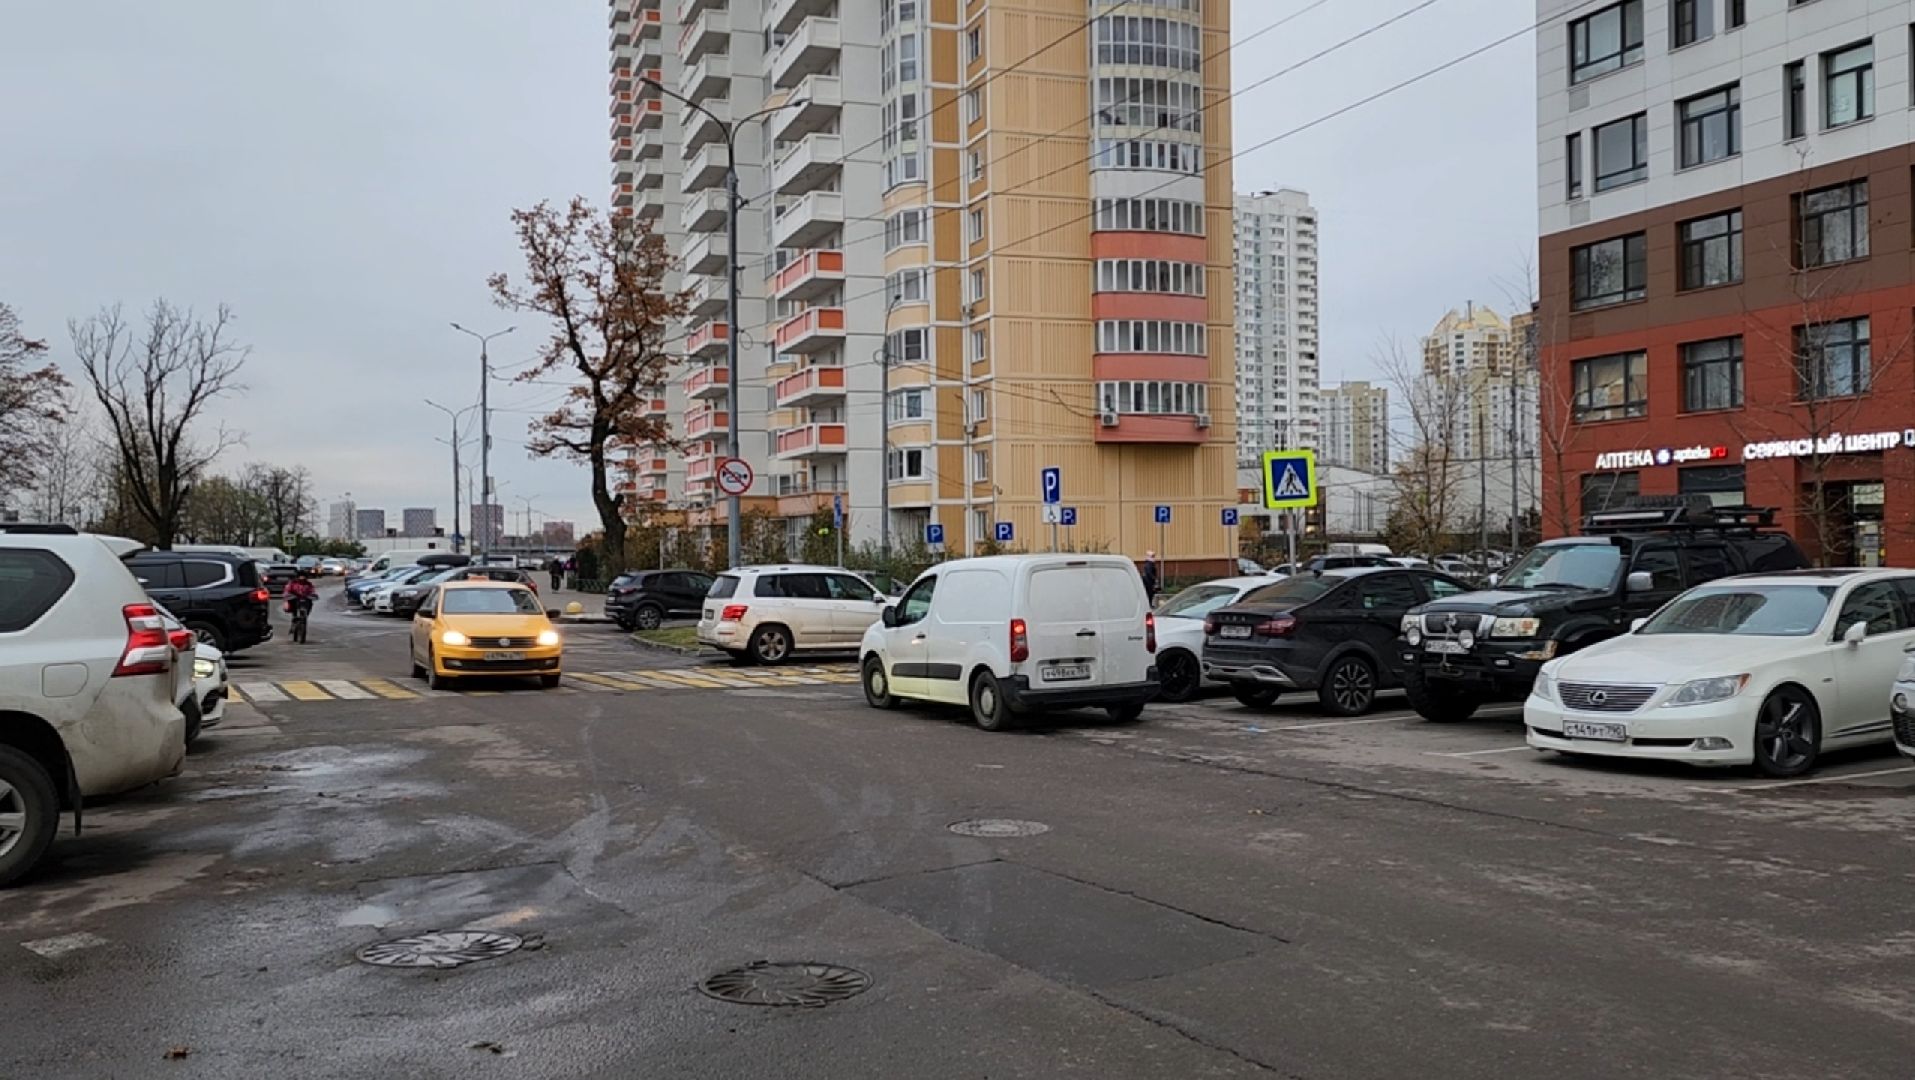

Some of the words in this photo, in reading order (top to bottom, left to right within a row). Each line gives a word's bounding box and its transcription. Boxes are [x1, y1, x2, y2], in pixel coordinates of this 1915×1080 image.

[1844, 431, 1900, 451] ЦЕНТР
[1595, 449, 1654, 469] АПТЕКА
[1045, 470, 1057, 501] P
